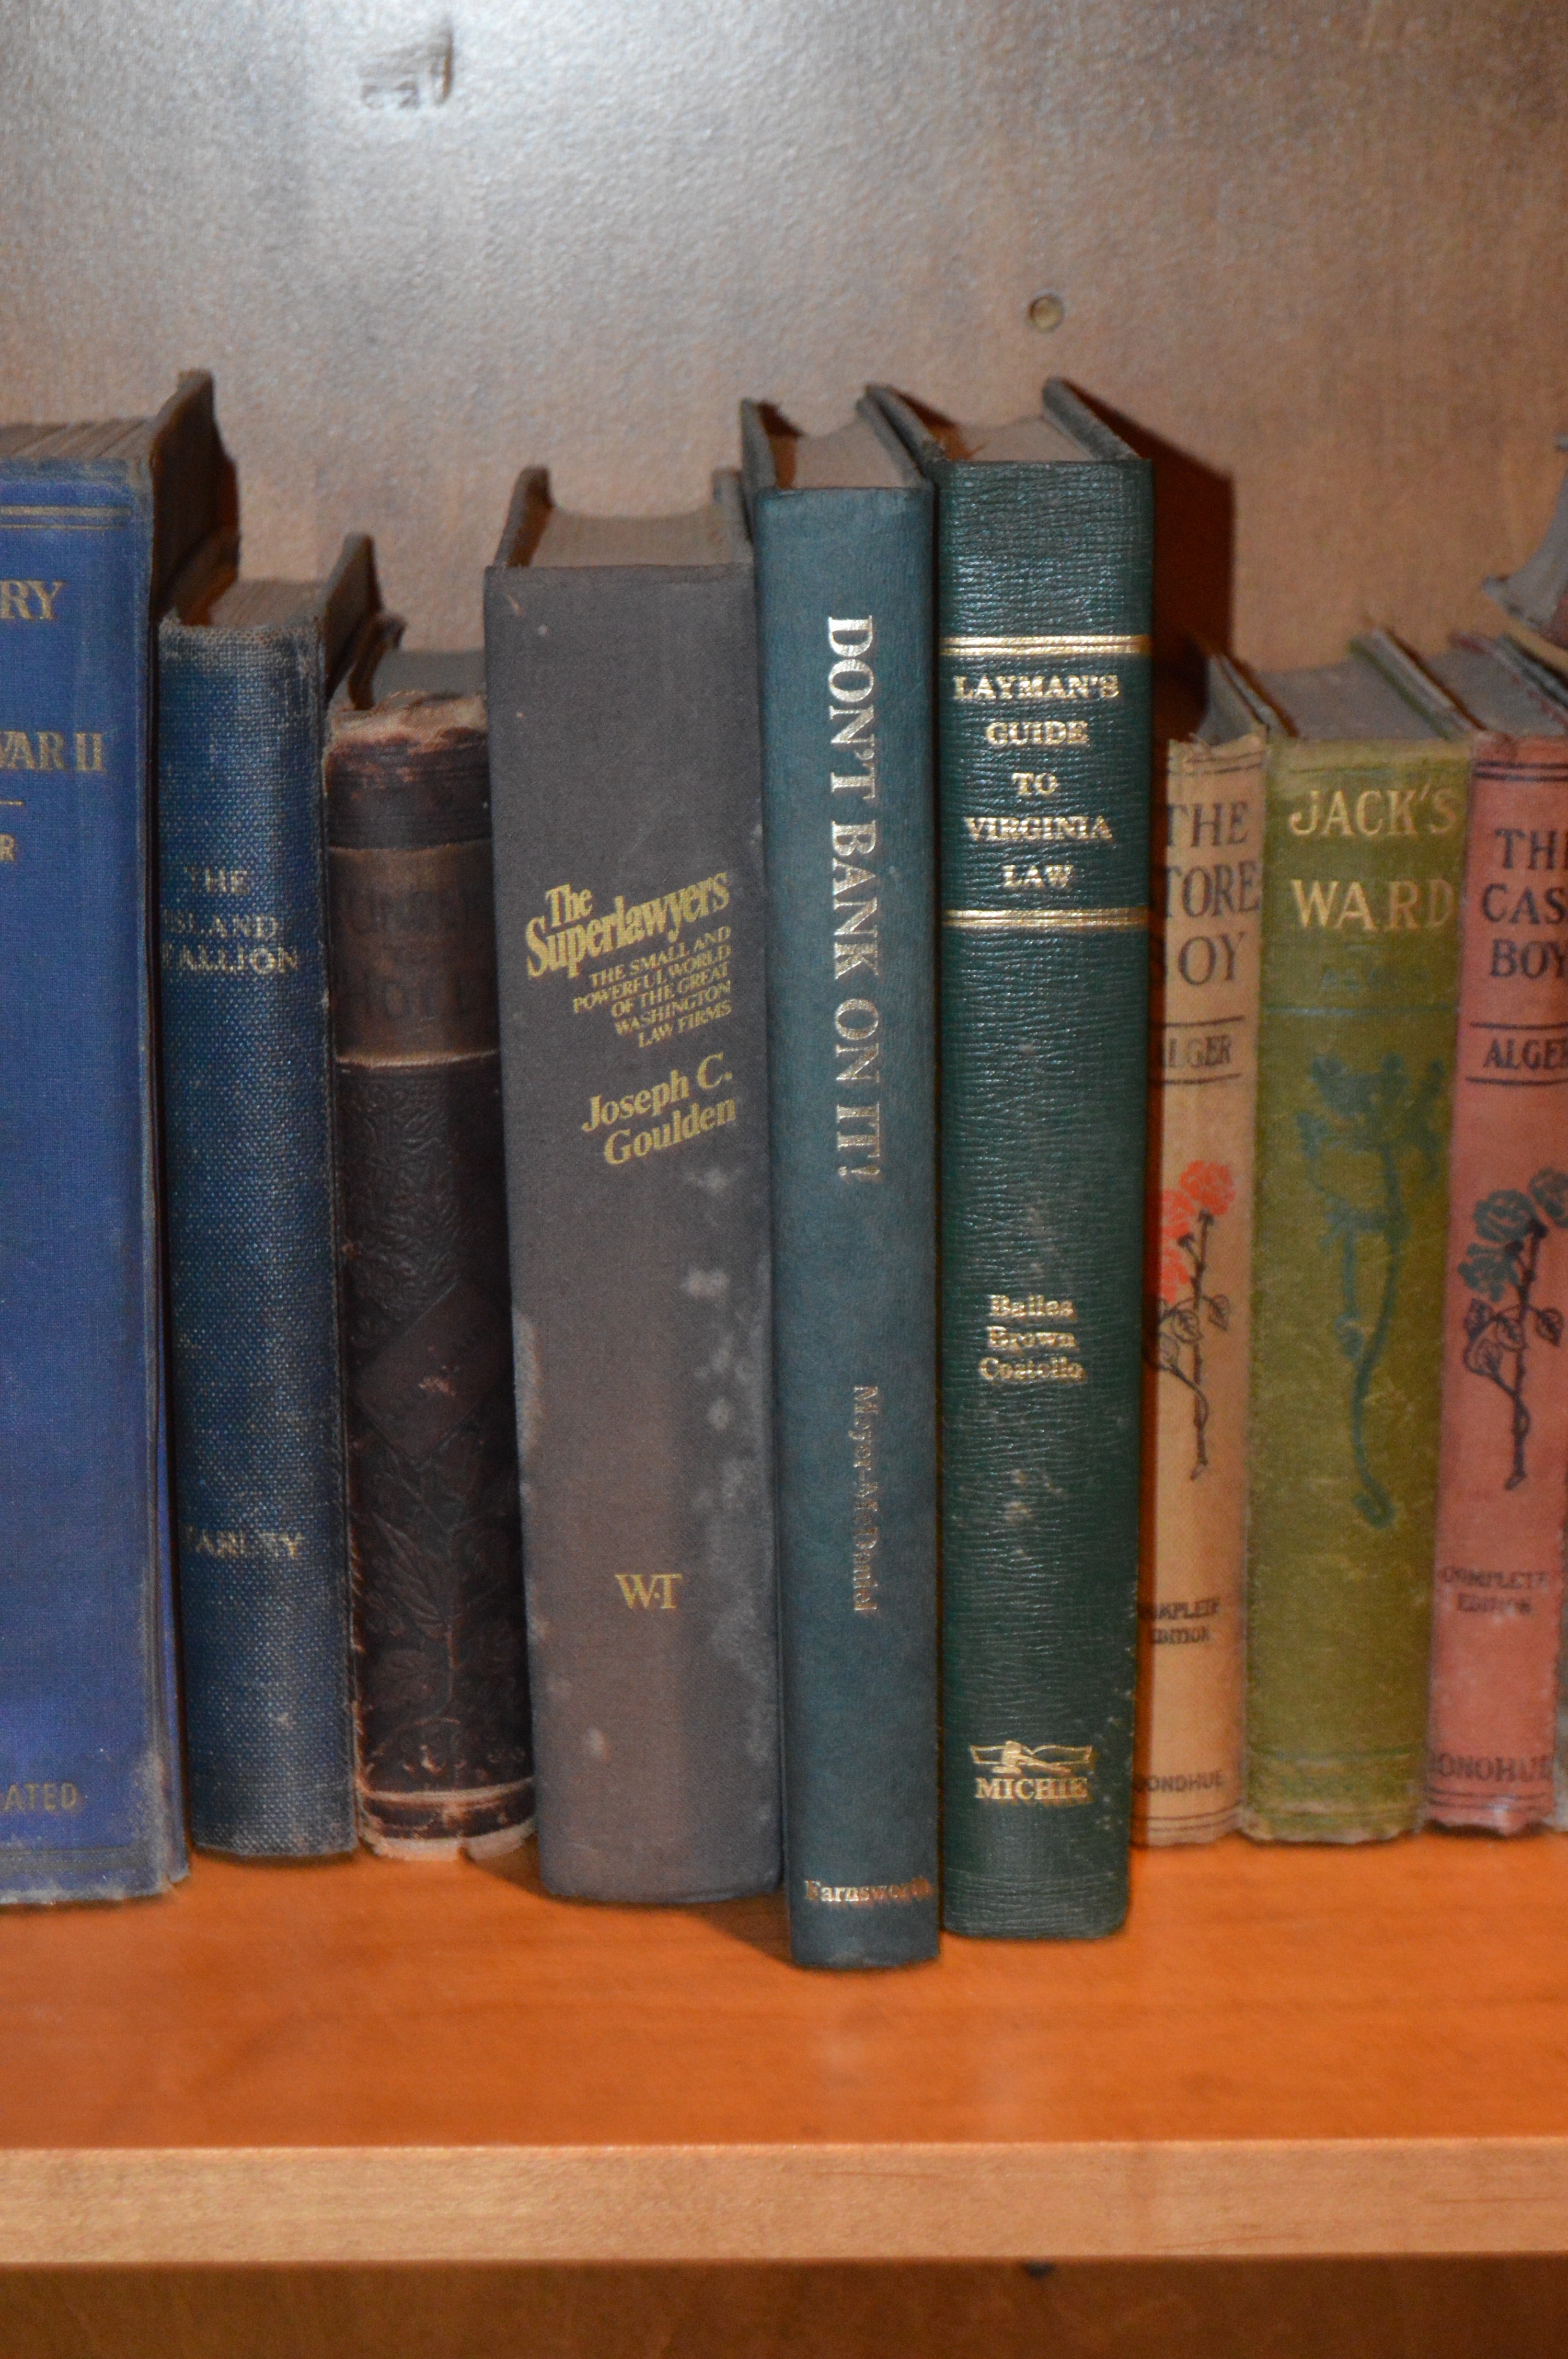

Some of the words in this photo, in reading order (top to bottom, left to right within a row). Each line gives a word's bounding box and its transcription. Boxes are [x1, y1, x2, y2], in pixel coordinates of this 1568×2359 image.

[828, 615, 875, 800] DON'T
[952, 674, 1120, 700] LAYMAN'S
[986, 720, 1090, 746] GUIDE
[1010, 772, 1060, 796] TO
[1288, 783, 1458, 837] JACK'S
[963, 815, 1114, 842] VIRGINIA
[1158, 800, 1250, 847] THE
[831, 819, 879, 980] BANK
[1001, 864, 1074, 889] LAW
[1157, 862, 1260, 918] TORE
[525, 872, 731, 979] Superlawyers
[545, 883, 593, 928] The
[1290, 878, 1455, 932] WARD
[1481, 883, 1568, 925] CAS
[573, 968, 668, 1014] POWERFUL
[668, 944, 731, 978] WORLD
[589, 964, 627, 989] THE
[629, 943, 690, 976] SMALL
[693, 925, 731, 953] AND
[611, 998, 635, 1018] OF
[640, 981, 676, 1009] THE
[678, 961, 729, 993] GREAT
[615, 980, 731, 1036] WASHINGTON
[638, 1022, 675, 1048] LAW
[678, 999, 732, 1034] FIRMS
[835, 998, 879, 1083] ON
[1160, 1034, 1232, 1069] LGER
[581, 1069, 690, 1133] Joseph
[696, 1051, 733, 1089] C.
[603, 1099, 736, 1165] Goulden
[836, 1101, 881, 1176] IT!
[975, 1777, 1089, 1800] MICHIE
